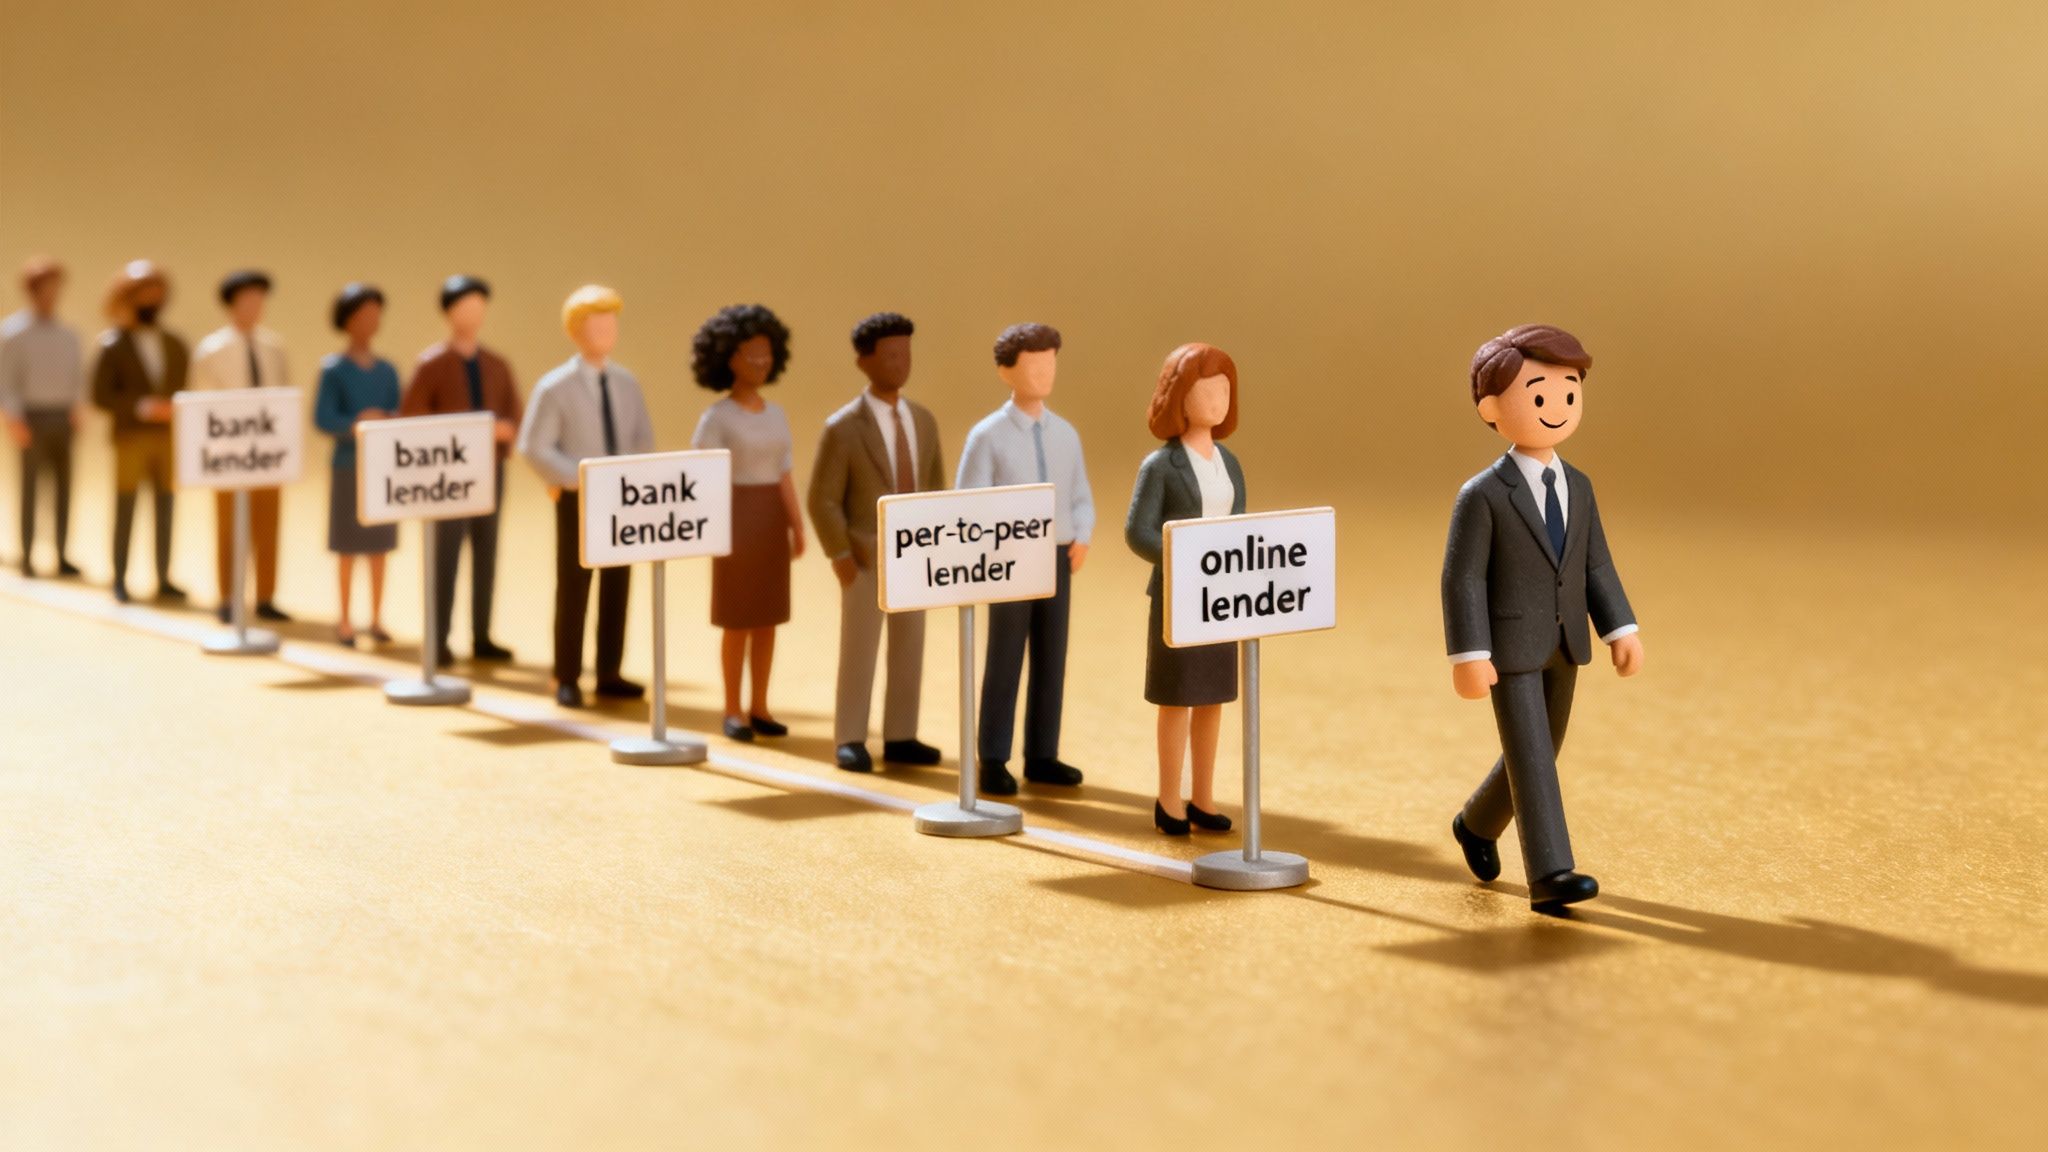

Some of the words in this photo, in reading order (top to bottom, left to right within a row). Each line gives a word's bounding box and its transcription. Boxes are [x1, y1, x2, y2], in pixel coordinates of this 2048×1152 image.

[206, 406, 276, 439] bank
[201, 445, 287, 474] lender
[395, 436, 468, 468] bank
[386, 471, 475, 504] lender
[621, 471, 696, 507] bank
[612, 511, 708, 547] lender
[896, 517, 1052, 558] per-to-peer
[927, 553, 1016, 587] lender
[1201, 535, 1307, 576] online
[1202, 580, 1311, 622] lender
